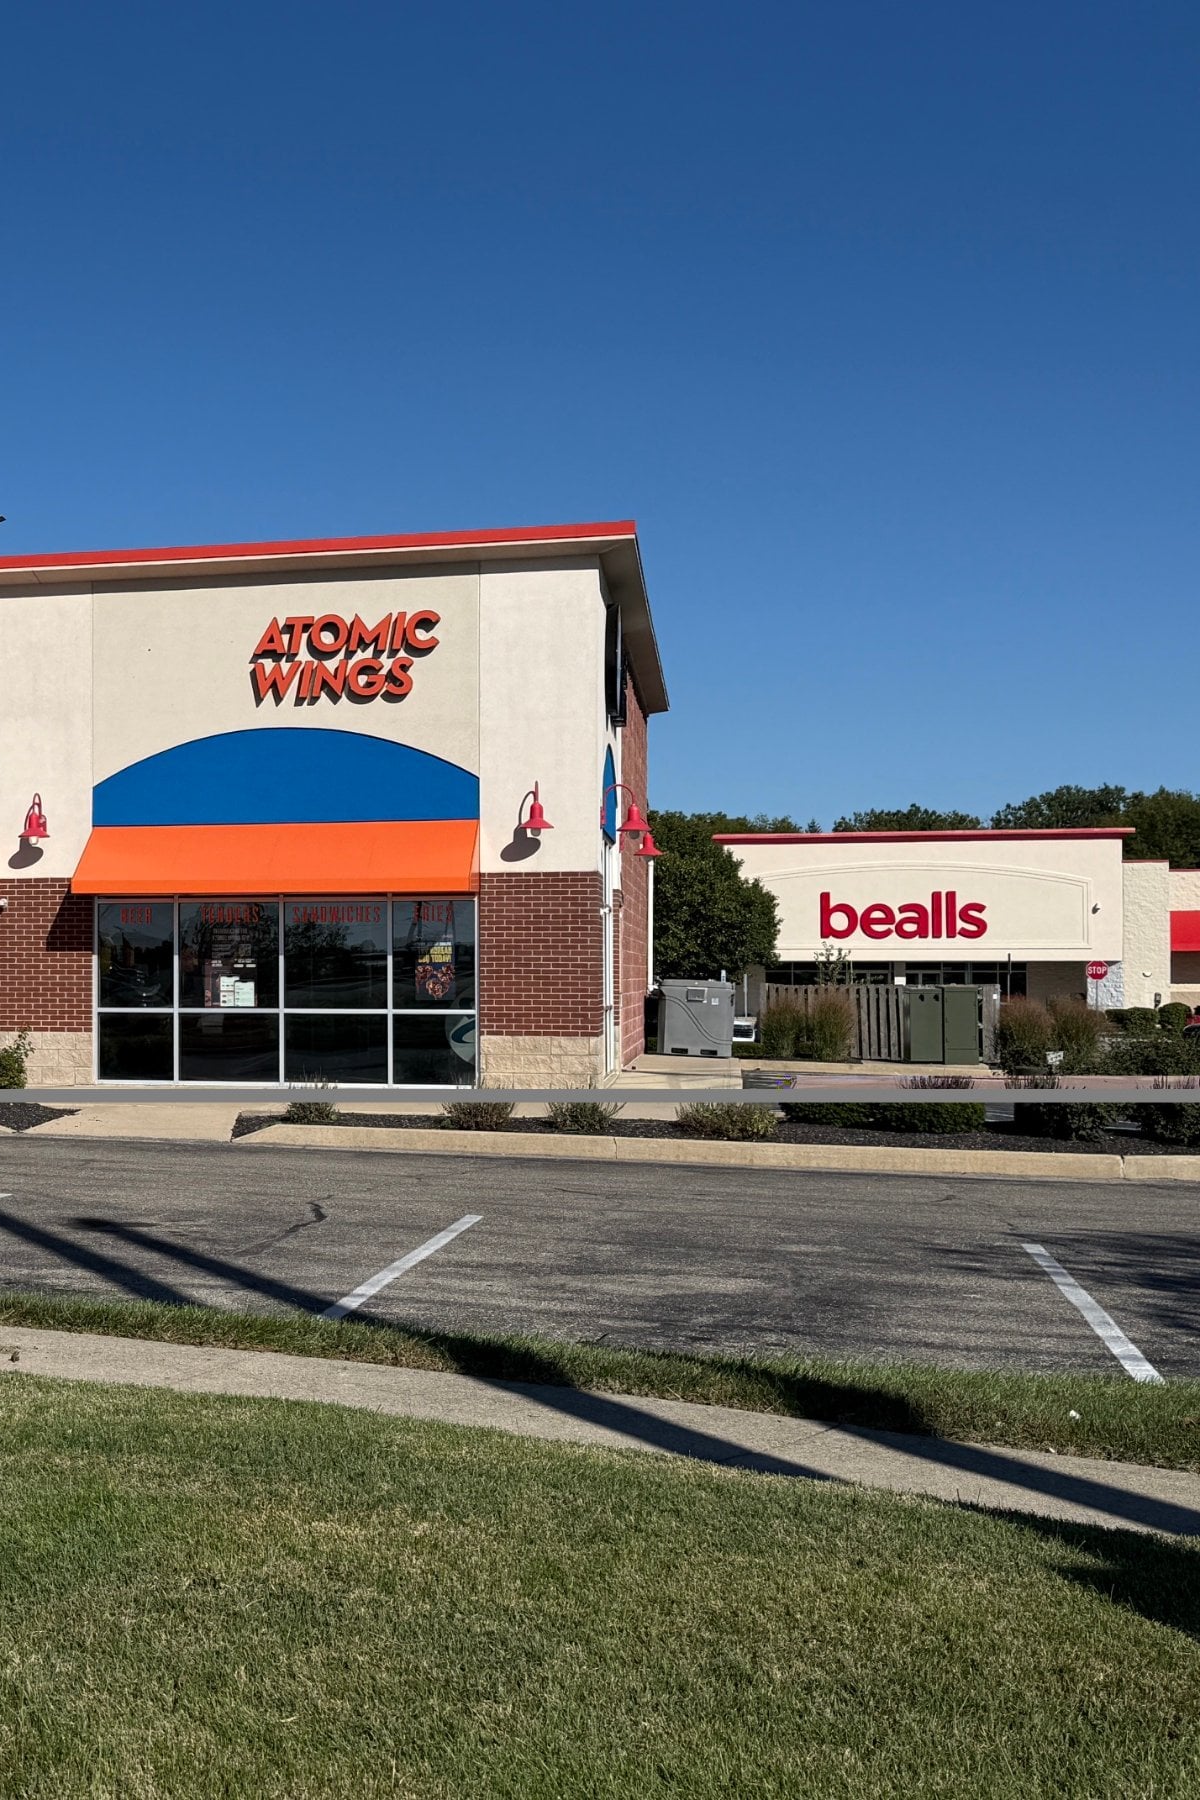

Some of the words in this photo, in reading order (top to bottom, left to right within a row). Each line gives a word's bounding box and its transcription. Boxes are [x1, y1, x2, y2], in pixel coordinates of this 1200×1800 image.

[253, 609, 441, 657] ATOMIC
[252, 656, 414, 700] WINGS
[201, 905, 260, 924] TENDERS
[292, 905, 381, 924] SANDWICHES
[413, 904, 453, 923] FRIES
[819, 890, 988, 940] bealls
[1087, 966, 1107, 975] STOP
